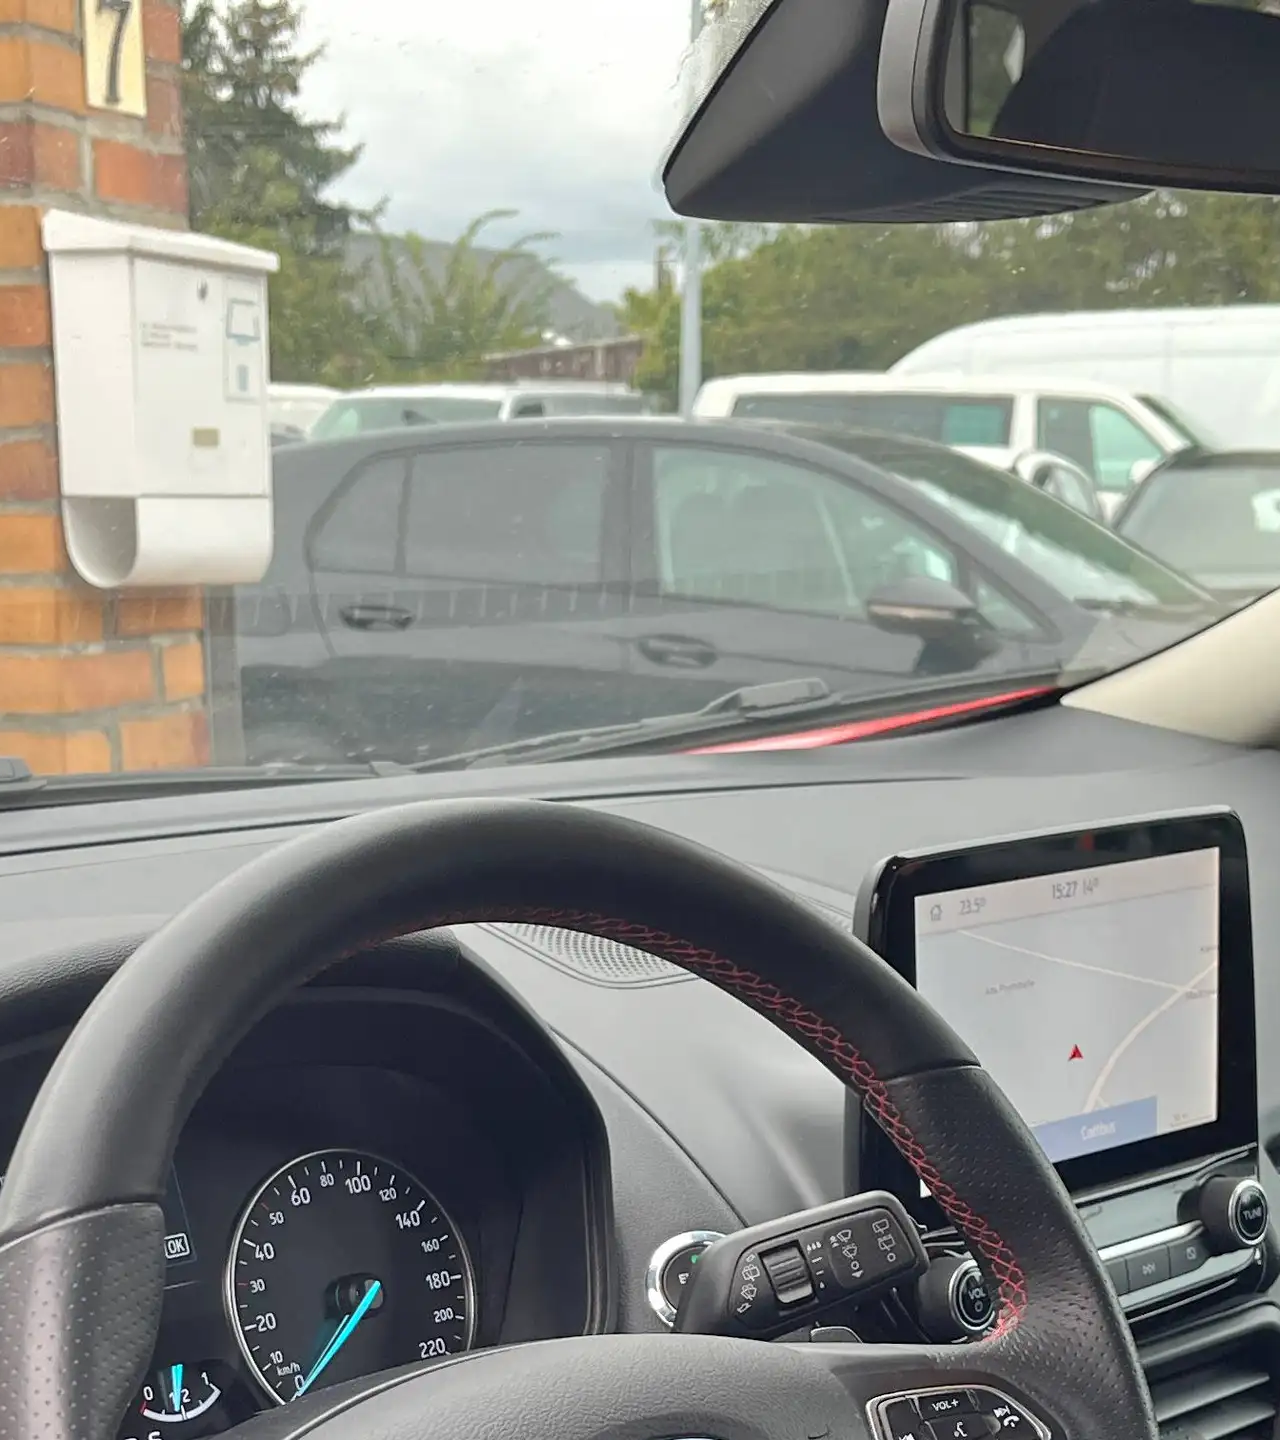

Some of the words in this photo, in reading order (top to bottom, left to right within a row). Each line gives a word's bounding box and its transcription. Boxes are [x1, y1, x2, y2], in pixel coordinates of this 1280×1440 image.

[97, 0, 132, 104] 7
[320, 1172, 334, 1187] 80
[345, 1175, 371, 1194] 100
[291, 1187, 311, 1206] 60
[379, 1186, 397, 1202] 120
[269, 1211, 285, 1226] 50
[395, 1210, 421, 1230] 140
[167, 1237, 186, 1253] OK
[255, 1242, 275, 1261] 40
[421, 1237, 440, 1253] 160
[249, 1277, 266, 1293] 30
[425, 1270, 451, 1290] 180
[968, 1287, 987, 1300] VOL
[255, 1313, 277, 1333] 20
[433, 1307, 454, 1323] 200
[418, 1337, 446, 1358] 220
[270, 1350, 283, 1364] 10
